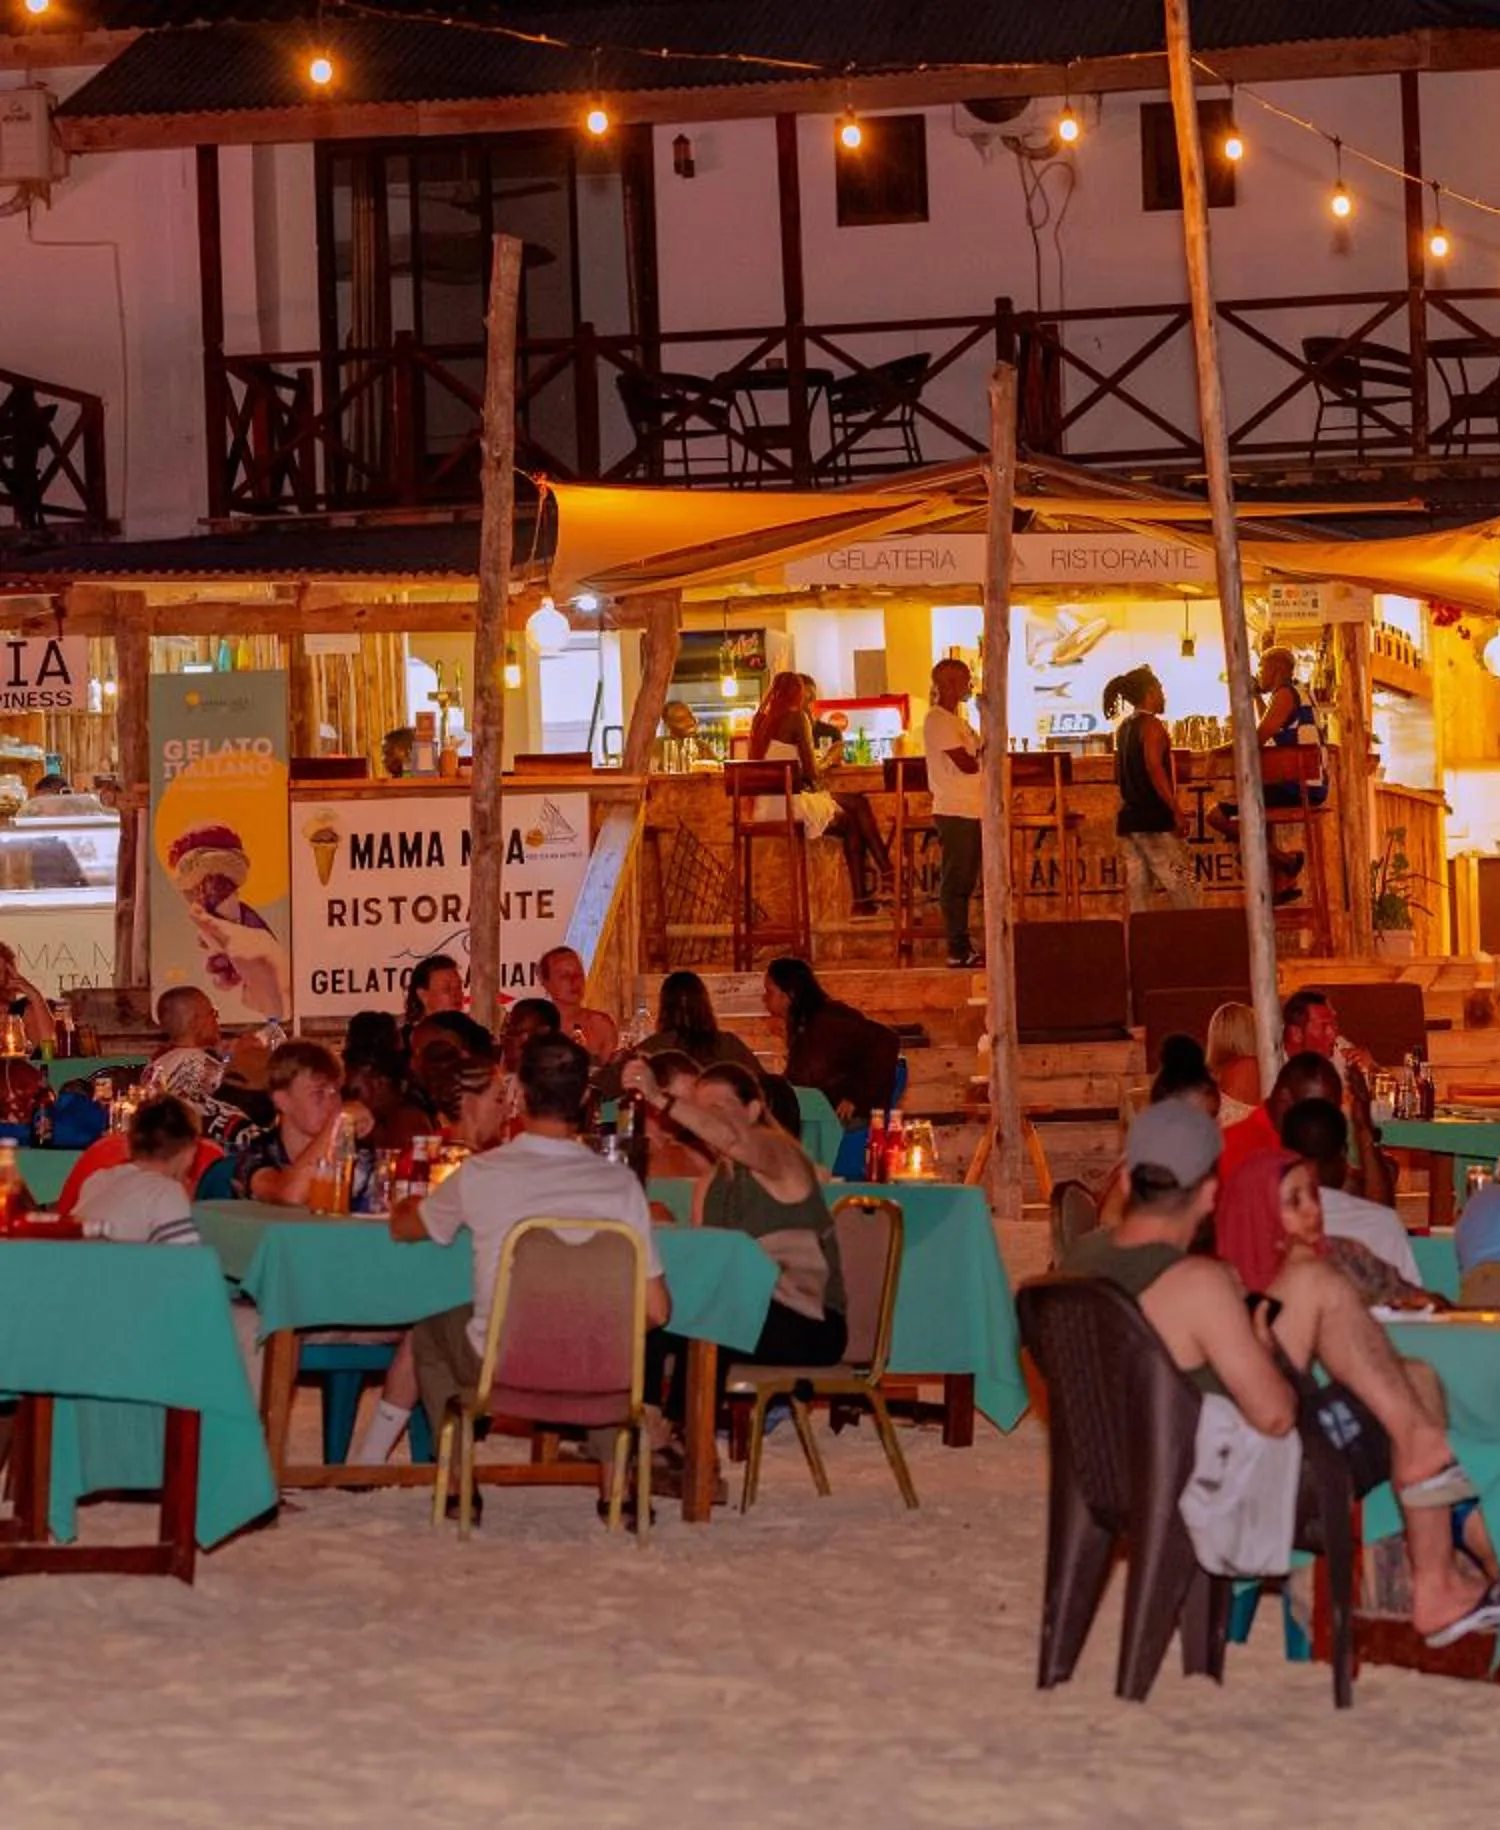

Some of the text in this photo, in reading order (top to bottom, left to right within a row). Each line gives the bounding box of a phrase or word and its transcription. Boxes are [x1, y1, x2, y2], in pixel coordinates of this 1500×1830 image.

[827, 548, 957, 571] GELATERIA
[1051, 547, 1199, 571] RISTORANTE
[0, 690, 72, 708] INESS
[163, 737, 273, 761] GELATO
[164, 759, 273, 780] ITALIANO
[350, 830, 445, 870] MAMA
